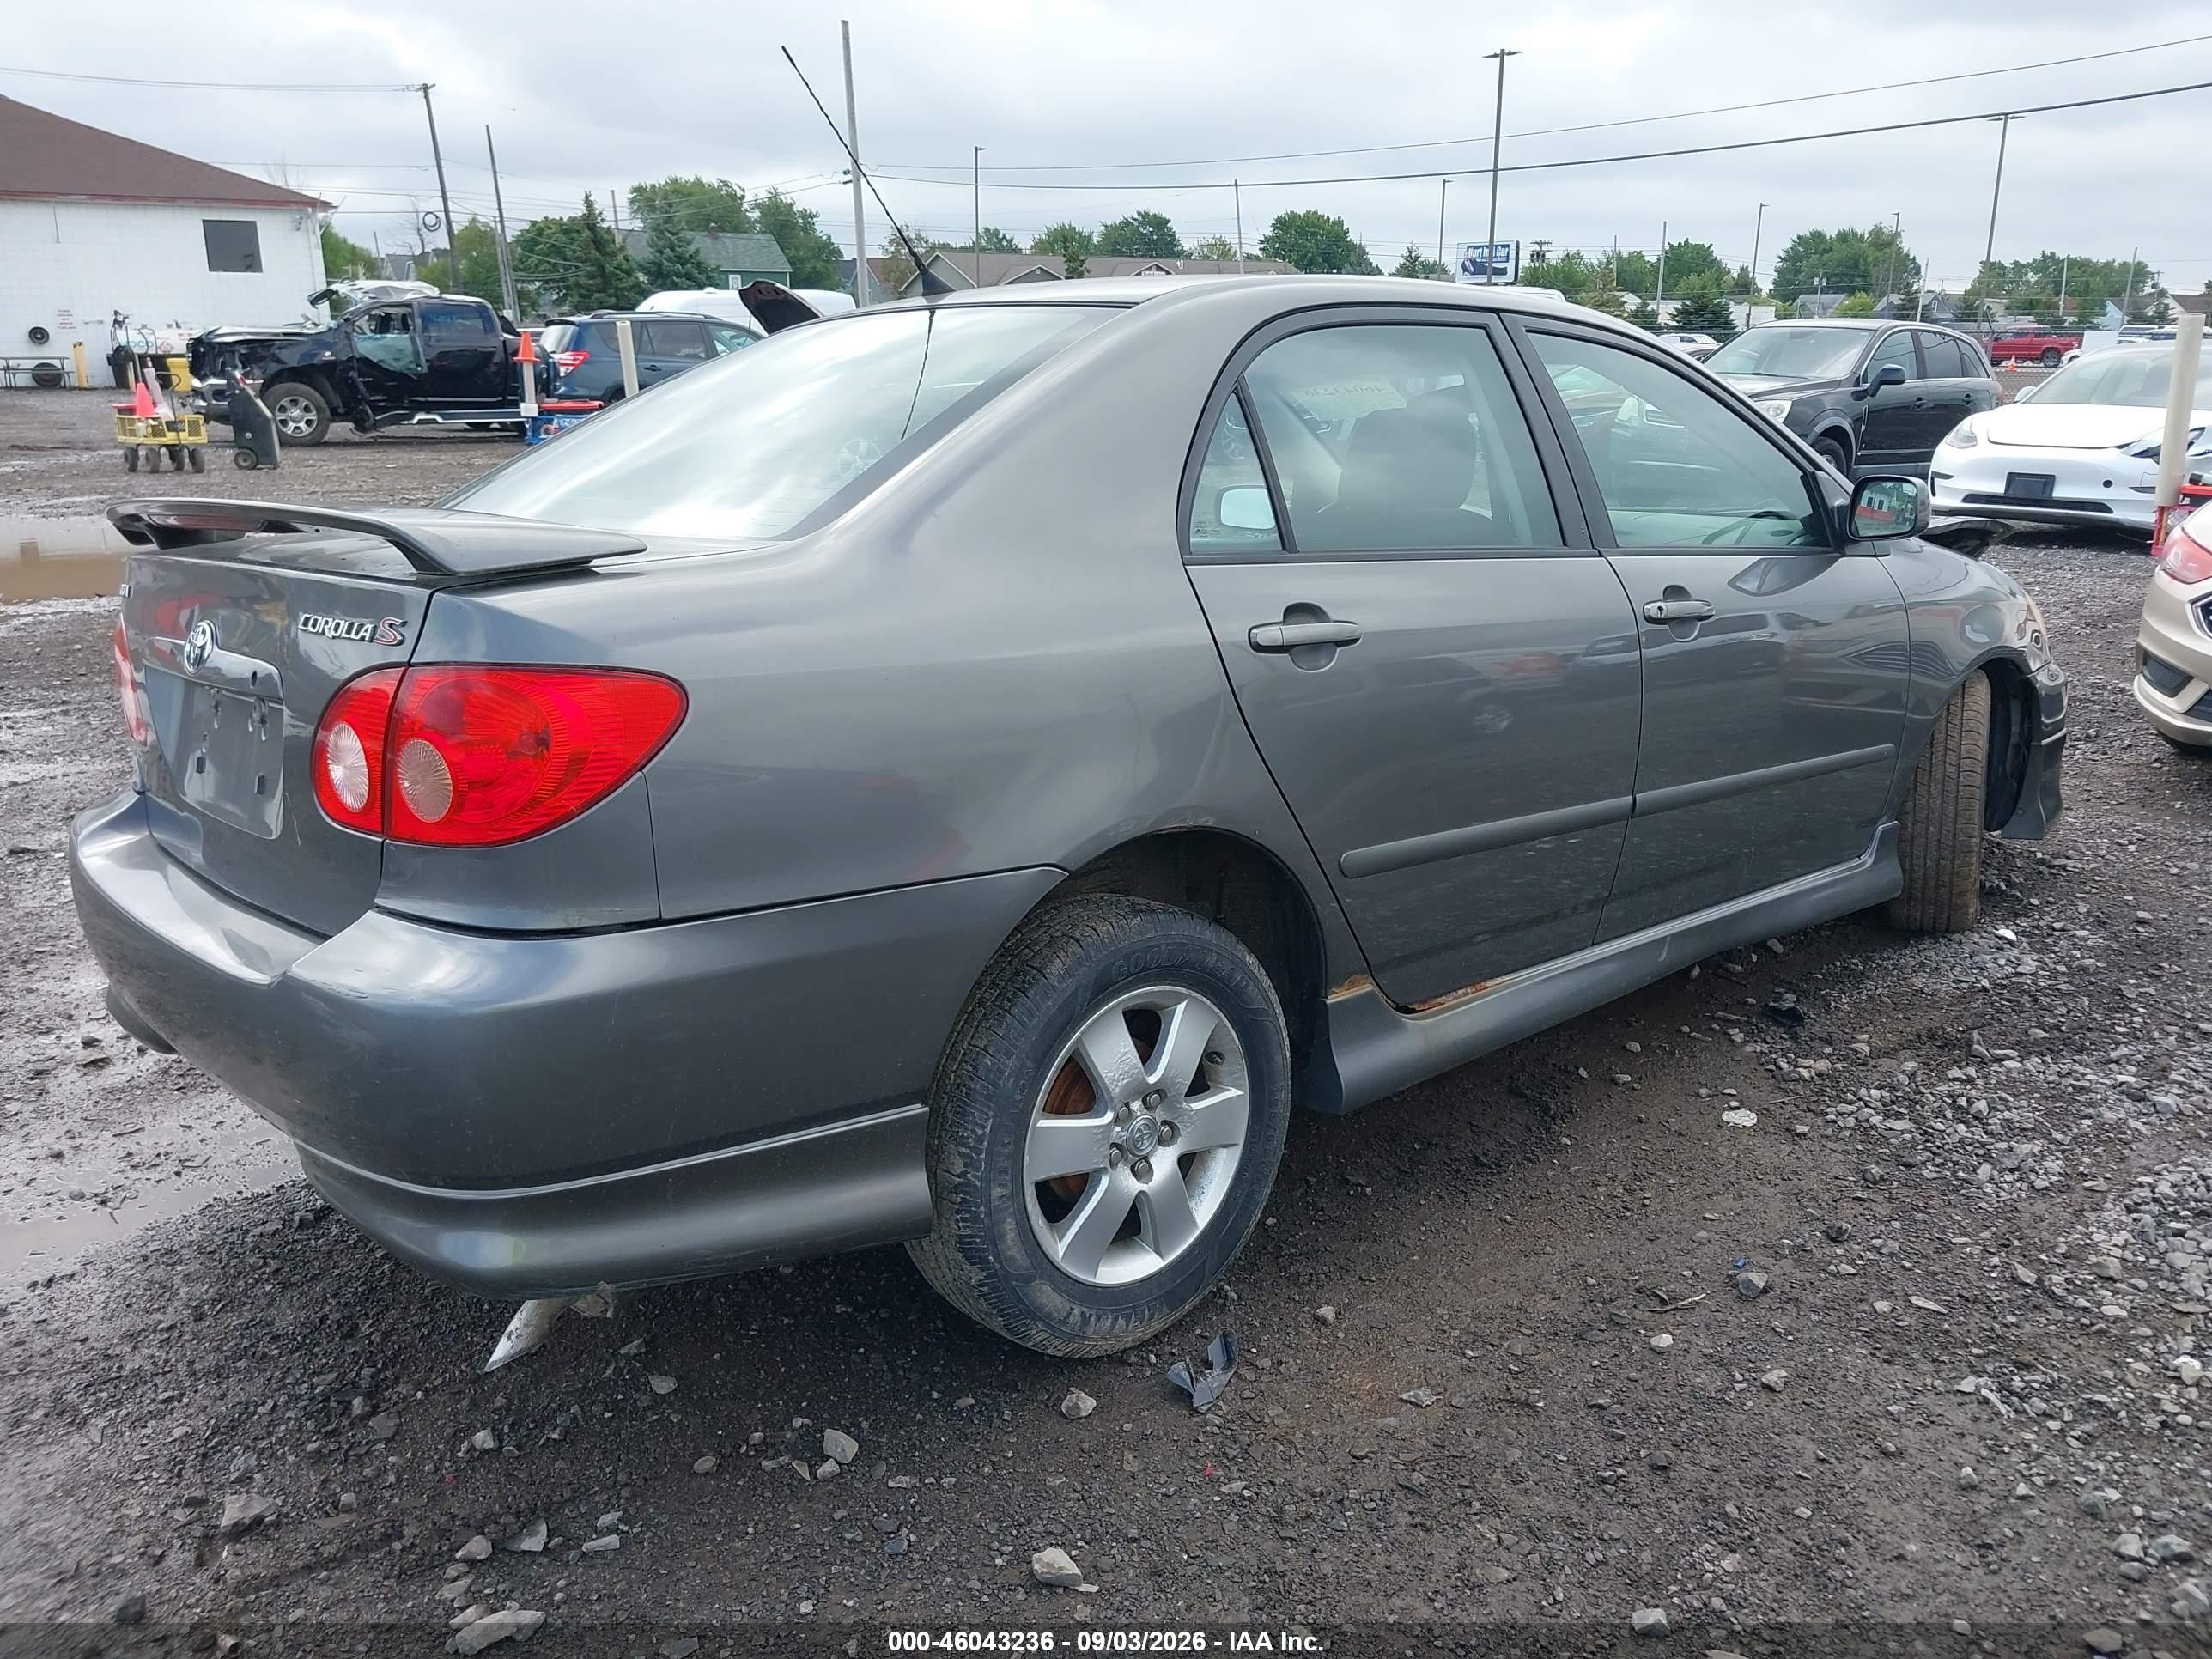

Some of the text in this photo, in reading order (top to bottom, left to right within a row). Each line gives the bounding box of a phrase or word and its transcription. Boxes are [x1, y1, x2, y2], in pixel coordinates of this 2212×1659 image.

[1496, 246, 1509, 257] Car
[298, 613, 409, 647] COROLLA S
